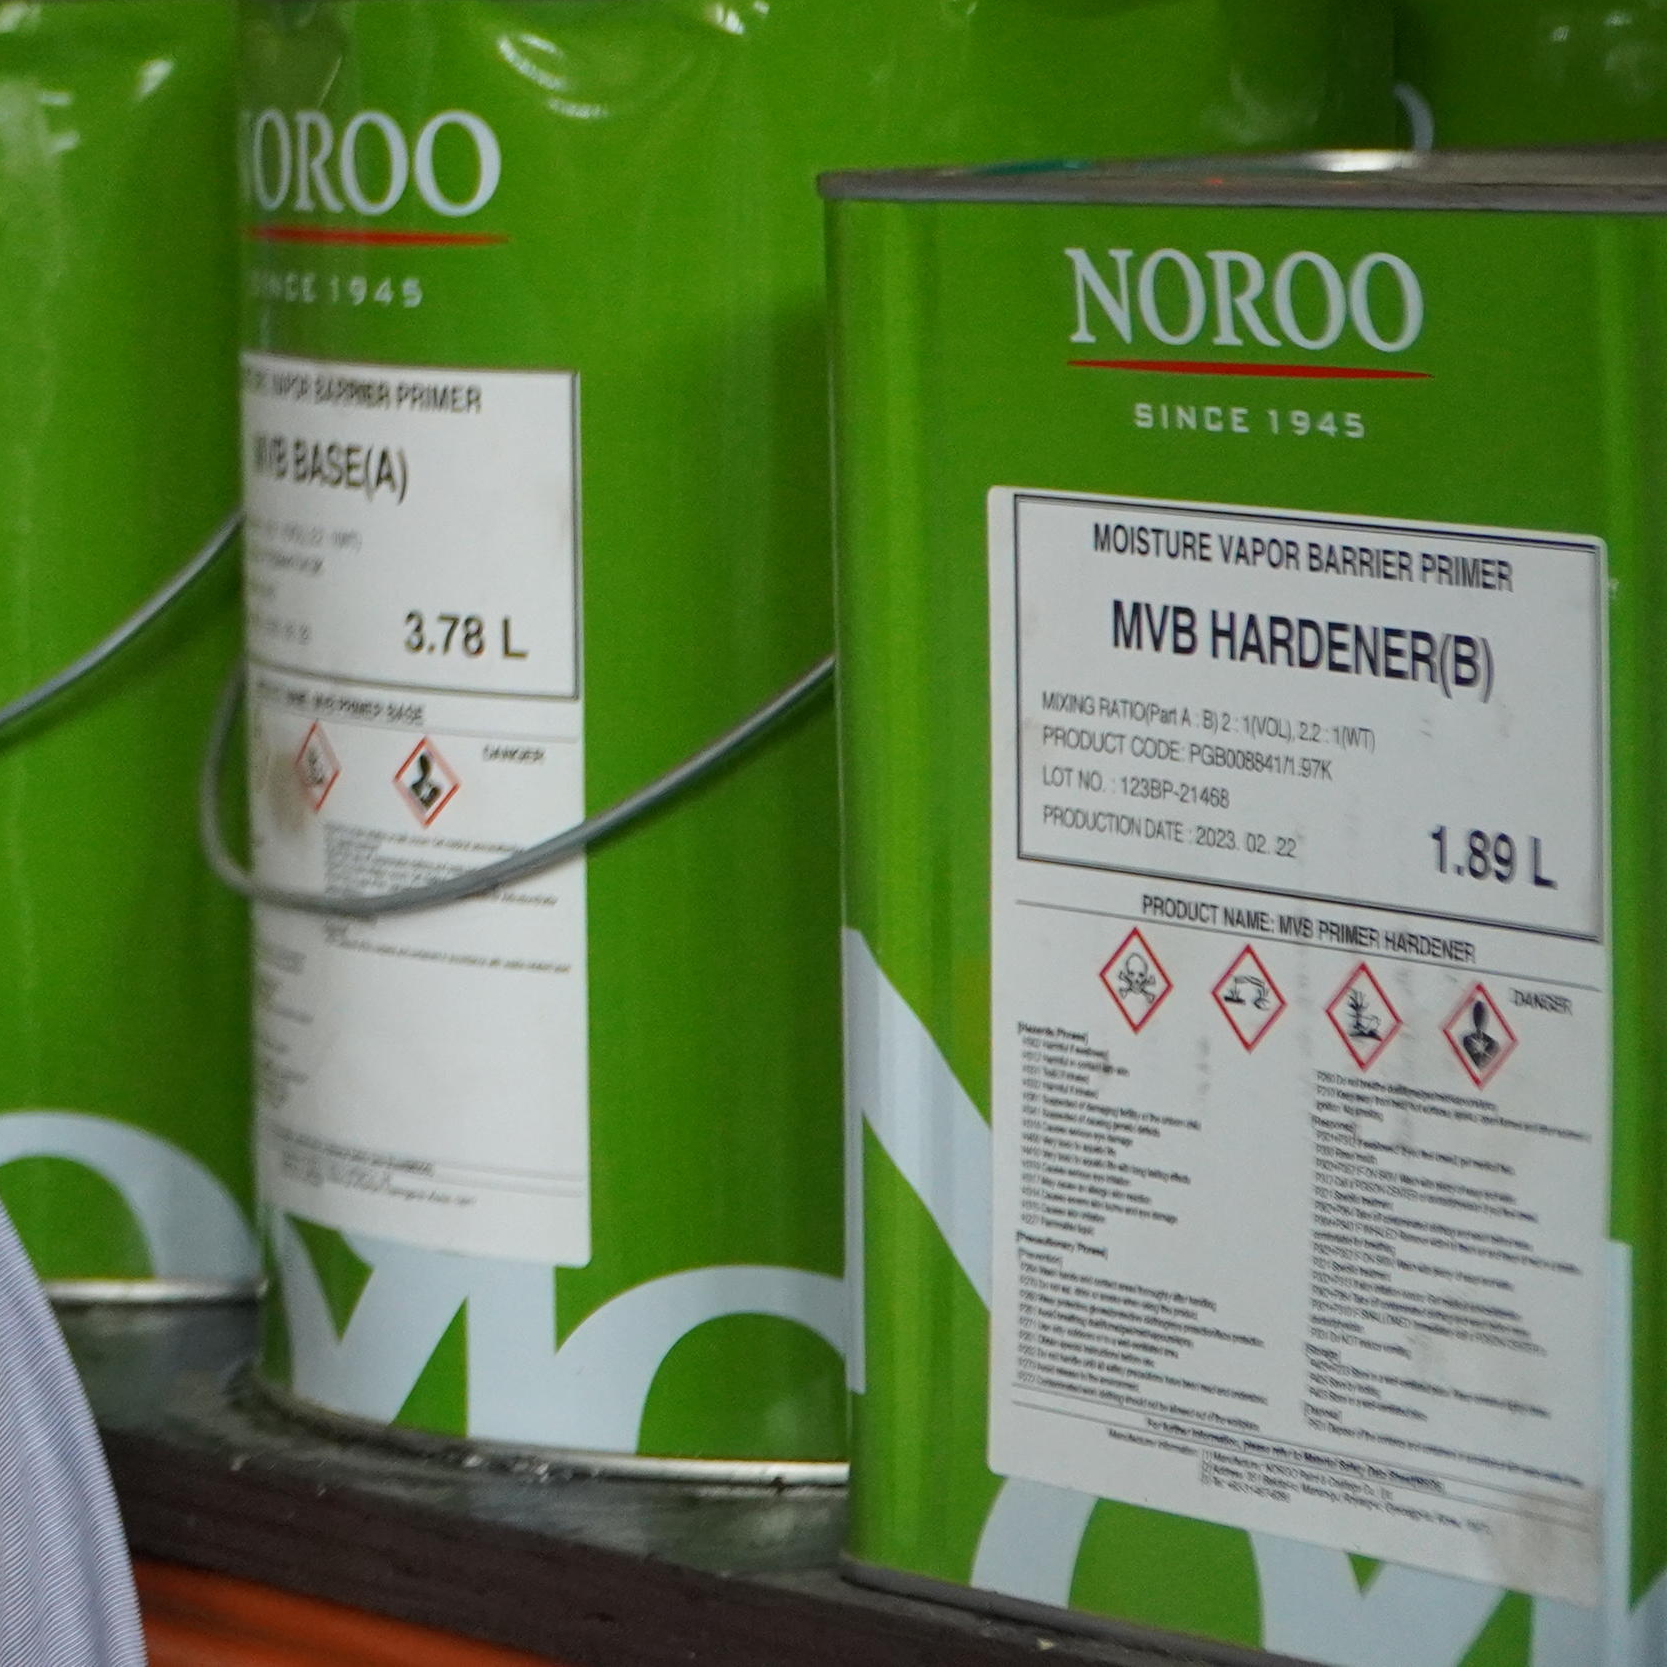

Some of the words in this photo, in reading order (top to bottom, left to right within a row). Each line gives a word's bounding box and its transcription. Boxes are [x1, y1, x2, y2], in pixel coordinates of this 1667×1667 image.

[329, 275, 423, 309] 1945
[1063, 246, 1425, 352] NOROO
[395, 381, 483, 414] PRIMER
[1133, 402, 1250, 433] SINCE
[1268, 407, 1365, 439] 1945
[291, 435, 410, 504] BASE(A)
[1093, 521, 1212, 562] MOISTURE
[1218, 533, 1300, 571] VAPOR
[1308, 543, 1414, 583] BARRIER
[1421, 554, 1514, 593] PRIMER
[404, 609, 486, 658] 3.78
[502, 616, 529, 659] L
[1112, 599, 1197, 655] MVB
[1210, 607, 1495, 703] HARDENER(B)
[1042, 691, 1095, 717] MIXING
[1334, 726, 1376, 754] 1(WT)
[1042, 724, 1127, 754] PRODUCT
[1131, 738, 1186, 763] CODE:
[1043, 765, 1073, 789] LOT
[1042, 804, 1142, 837] PRODUCTION
[1144, 818, 1185, 843] DATE
[1275, 836, 1298, 859] 22
[1429, 824, 1517, 884] 1.89
[1531, 836, 1558, 891] L
[1142, 894, 1220, 927] PRODUCT
[1223, 906, 1275, 934] NAME:
[1317, 920, 1381, 951] PRIMER
[1384, 931, 1477, 966] HARDENER
[1509, 988, 1574, 1016] DANGER
